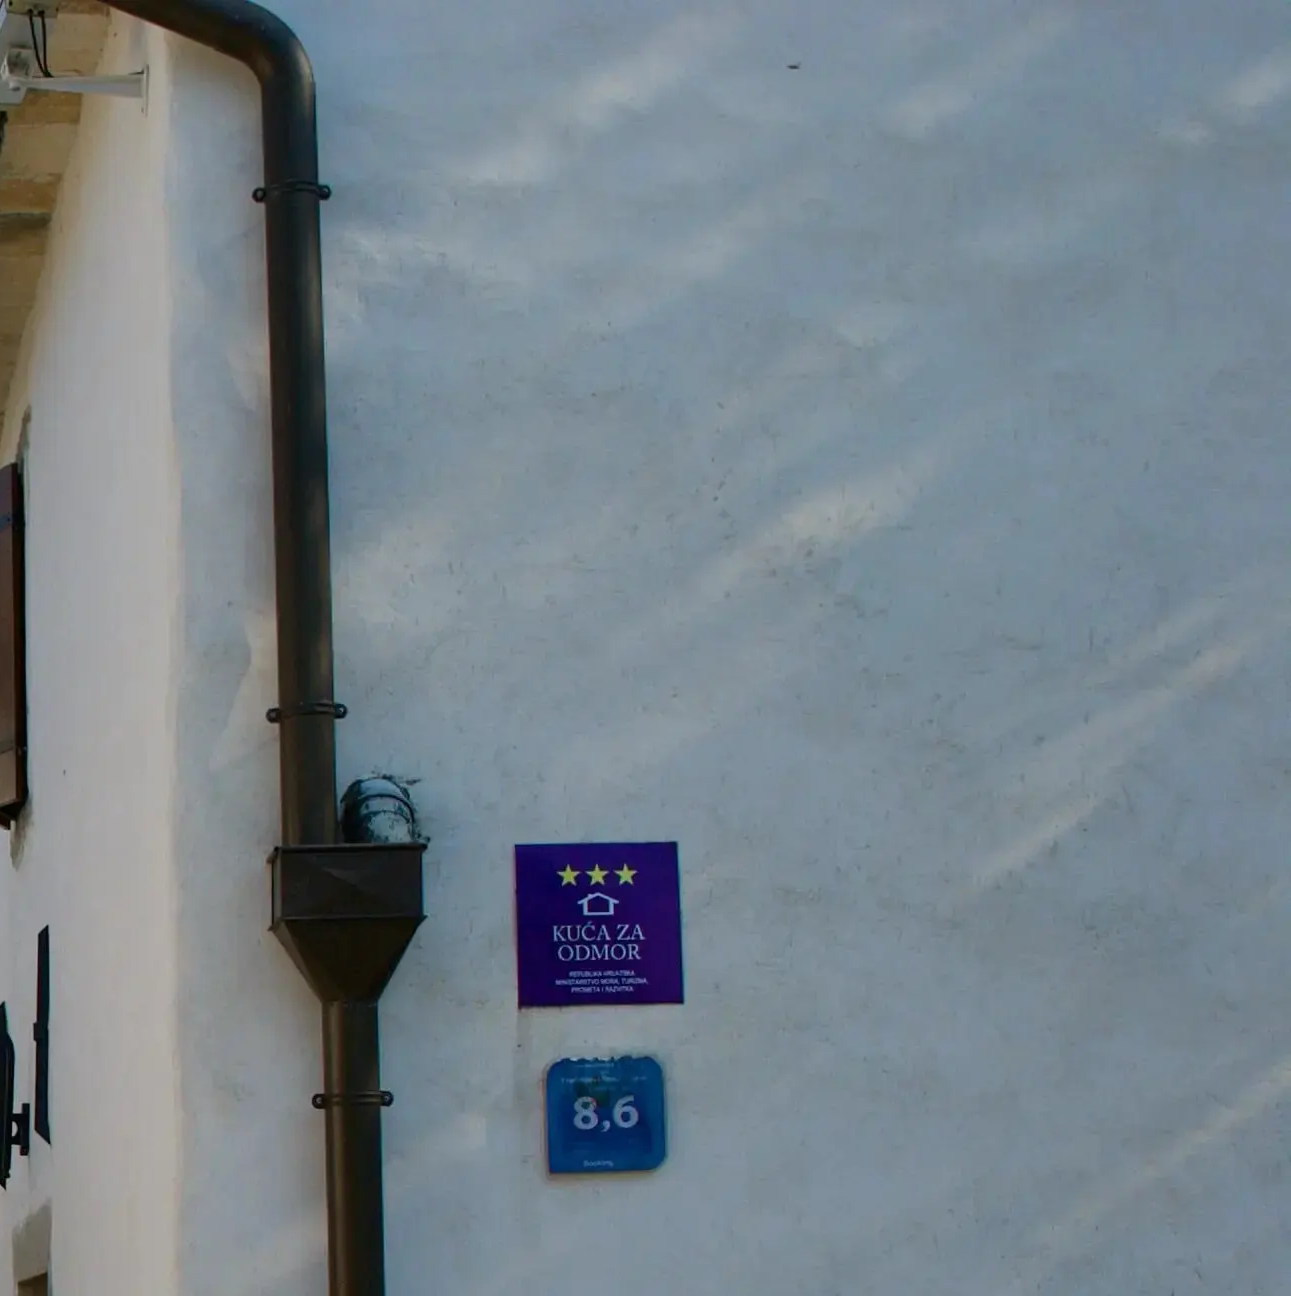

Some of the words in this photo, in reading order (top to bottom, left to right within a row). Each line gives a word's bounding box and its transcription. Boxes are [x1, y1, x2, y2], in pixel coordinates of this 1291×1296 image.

[552, 921, 611, 942] KUĆA
[616, 924, 646, 941] ZA
[557, 943, 642, 962] ODMOR
[573, 1095, 639, 1132] 8,6
